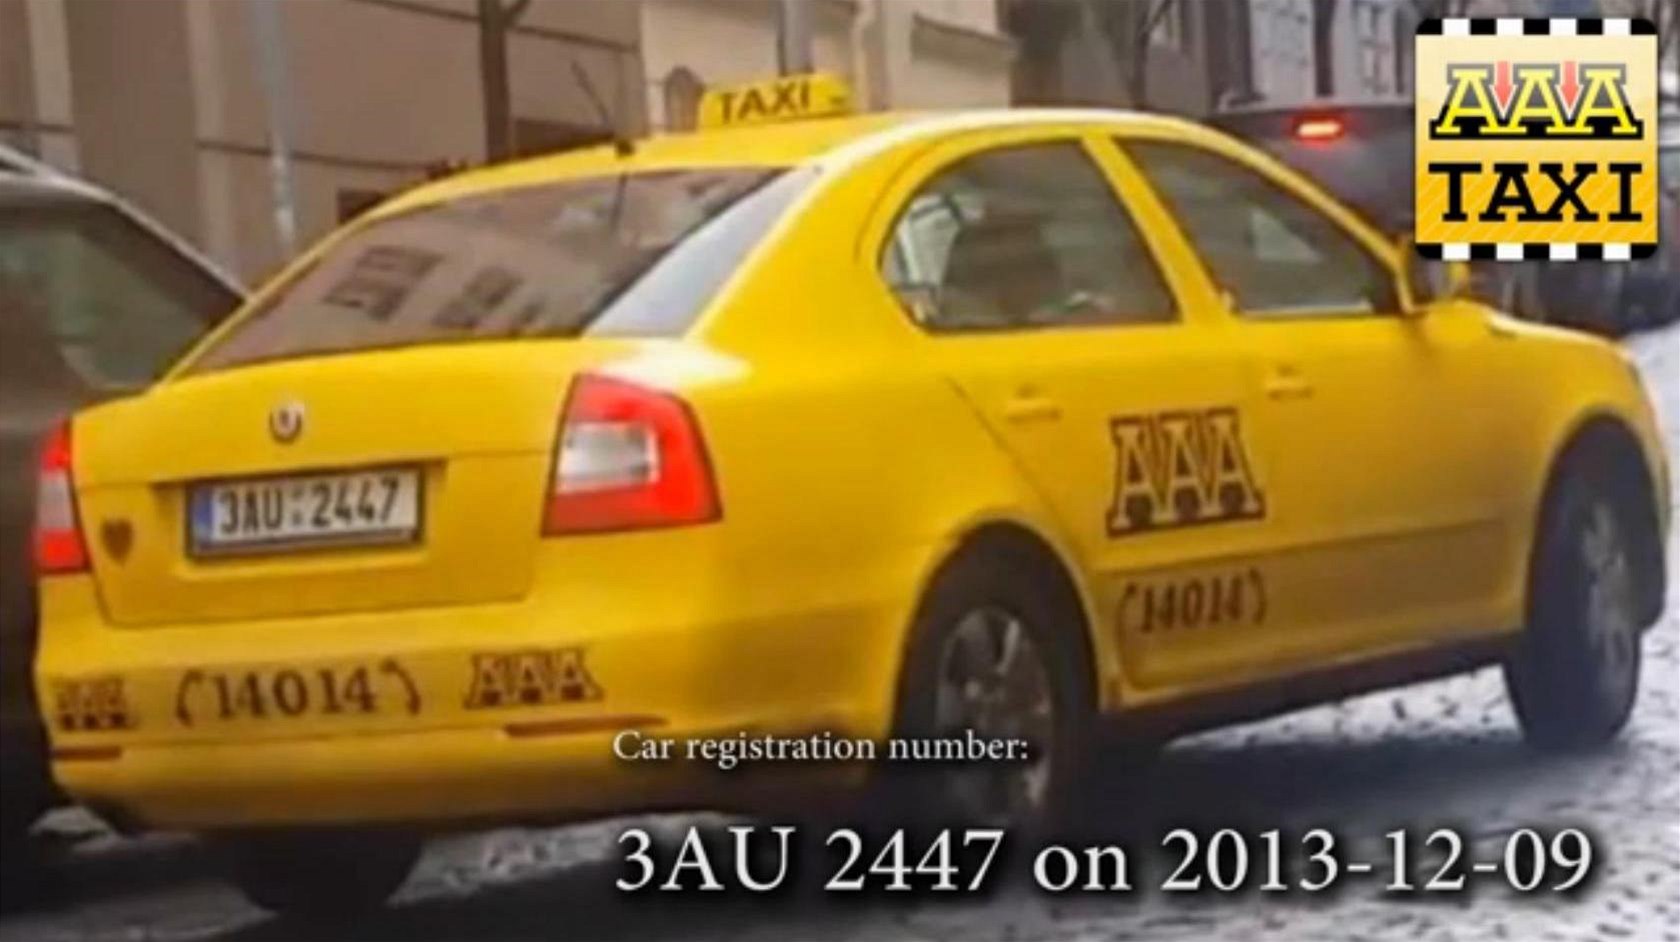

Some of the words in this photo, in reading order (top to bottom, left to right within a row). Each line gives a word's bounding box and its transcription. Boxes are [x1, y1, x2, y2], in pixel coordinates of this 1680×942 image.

[719, 80, 811, 125] TAXI
[1105, 406, 1266, 539] AAA
[219, 487, 283, 535] 3AU
[310, 476, 400, 528] 2447
[463, 647, 604, 710] AAA
